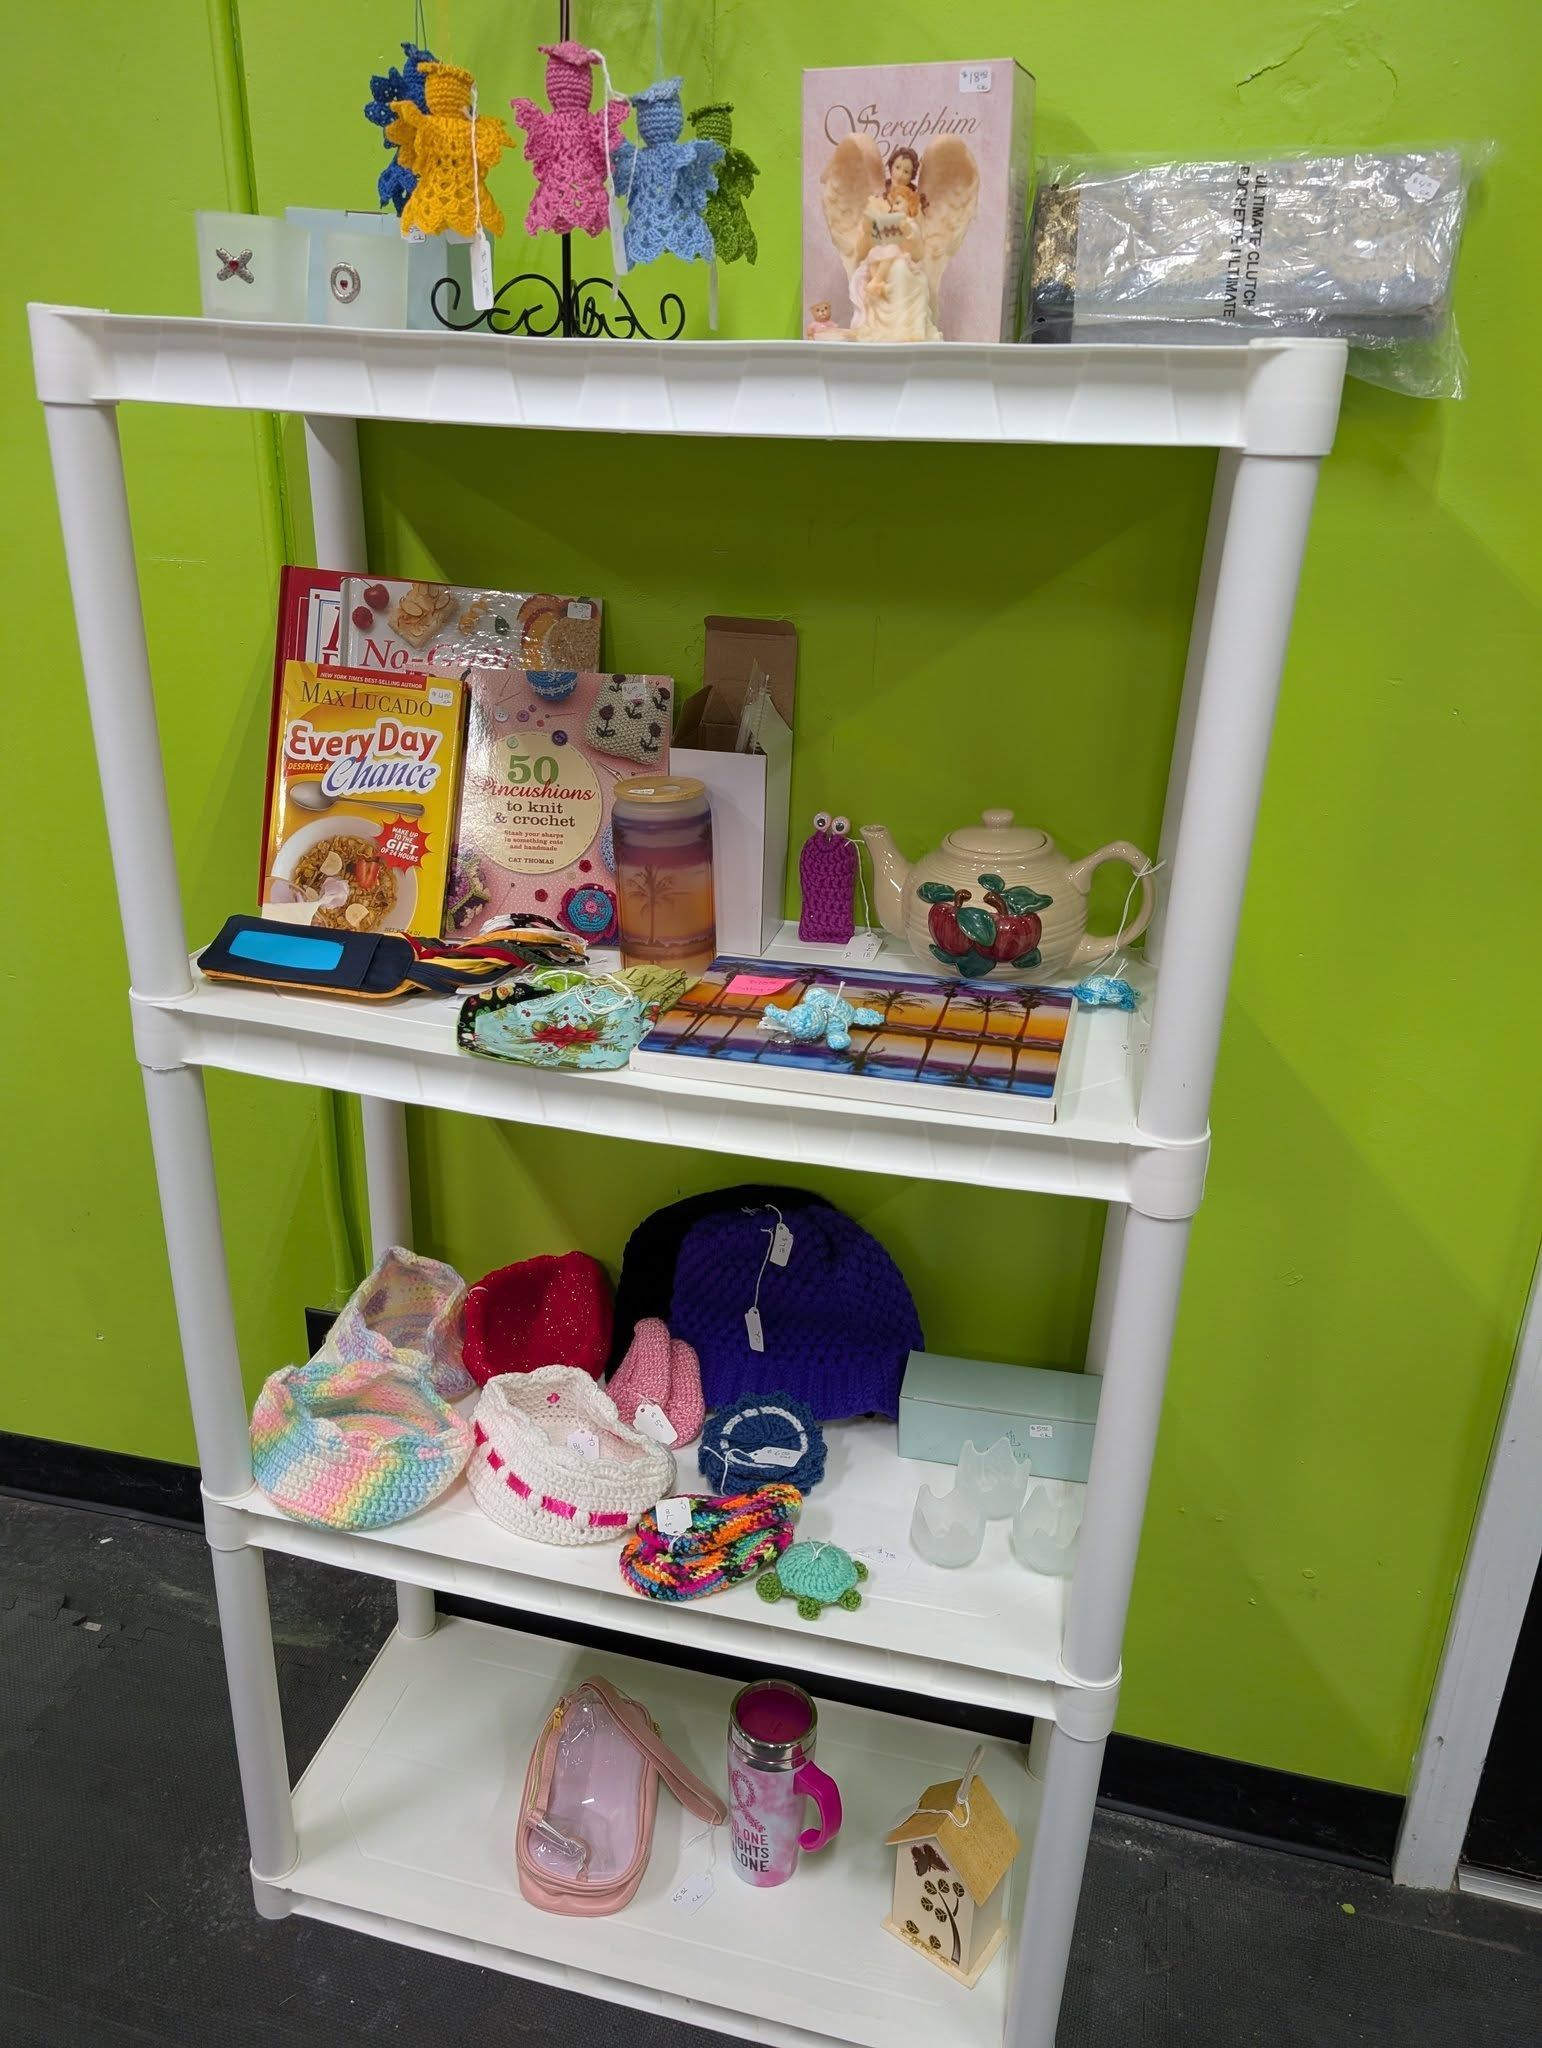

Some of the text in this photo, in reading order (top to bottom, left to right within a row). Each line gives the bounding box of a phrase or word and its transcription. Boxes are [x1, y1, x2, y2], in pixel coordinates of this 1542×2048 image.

[824, 103, 980, 147] Seraphim
[1250, 174, 1268, 249] ULTIMATE
[364, 677, 400, 686] BEST-SELLING
[302, 680, 433, 717] MAX LUCADO
[289, 722, 438, 764] Every Day
[287, 762, 324, 771] DESERVES
[326, 756, 436, 791] Chance
[507, 755, 559, 785] 50
[507, 800, 563, 814] to knit
[495, 812, 576, 827] & crochet
[386, 839, 419, 855] GIFT
[402, 835, 414, 843] THE
[389, 849, 397, 857] 24
[398, 851, 419, 862] HOURS
[743, 1828, 768, 1846] ONE
